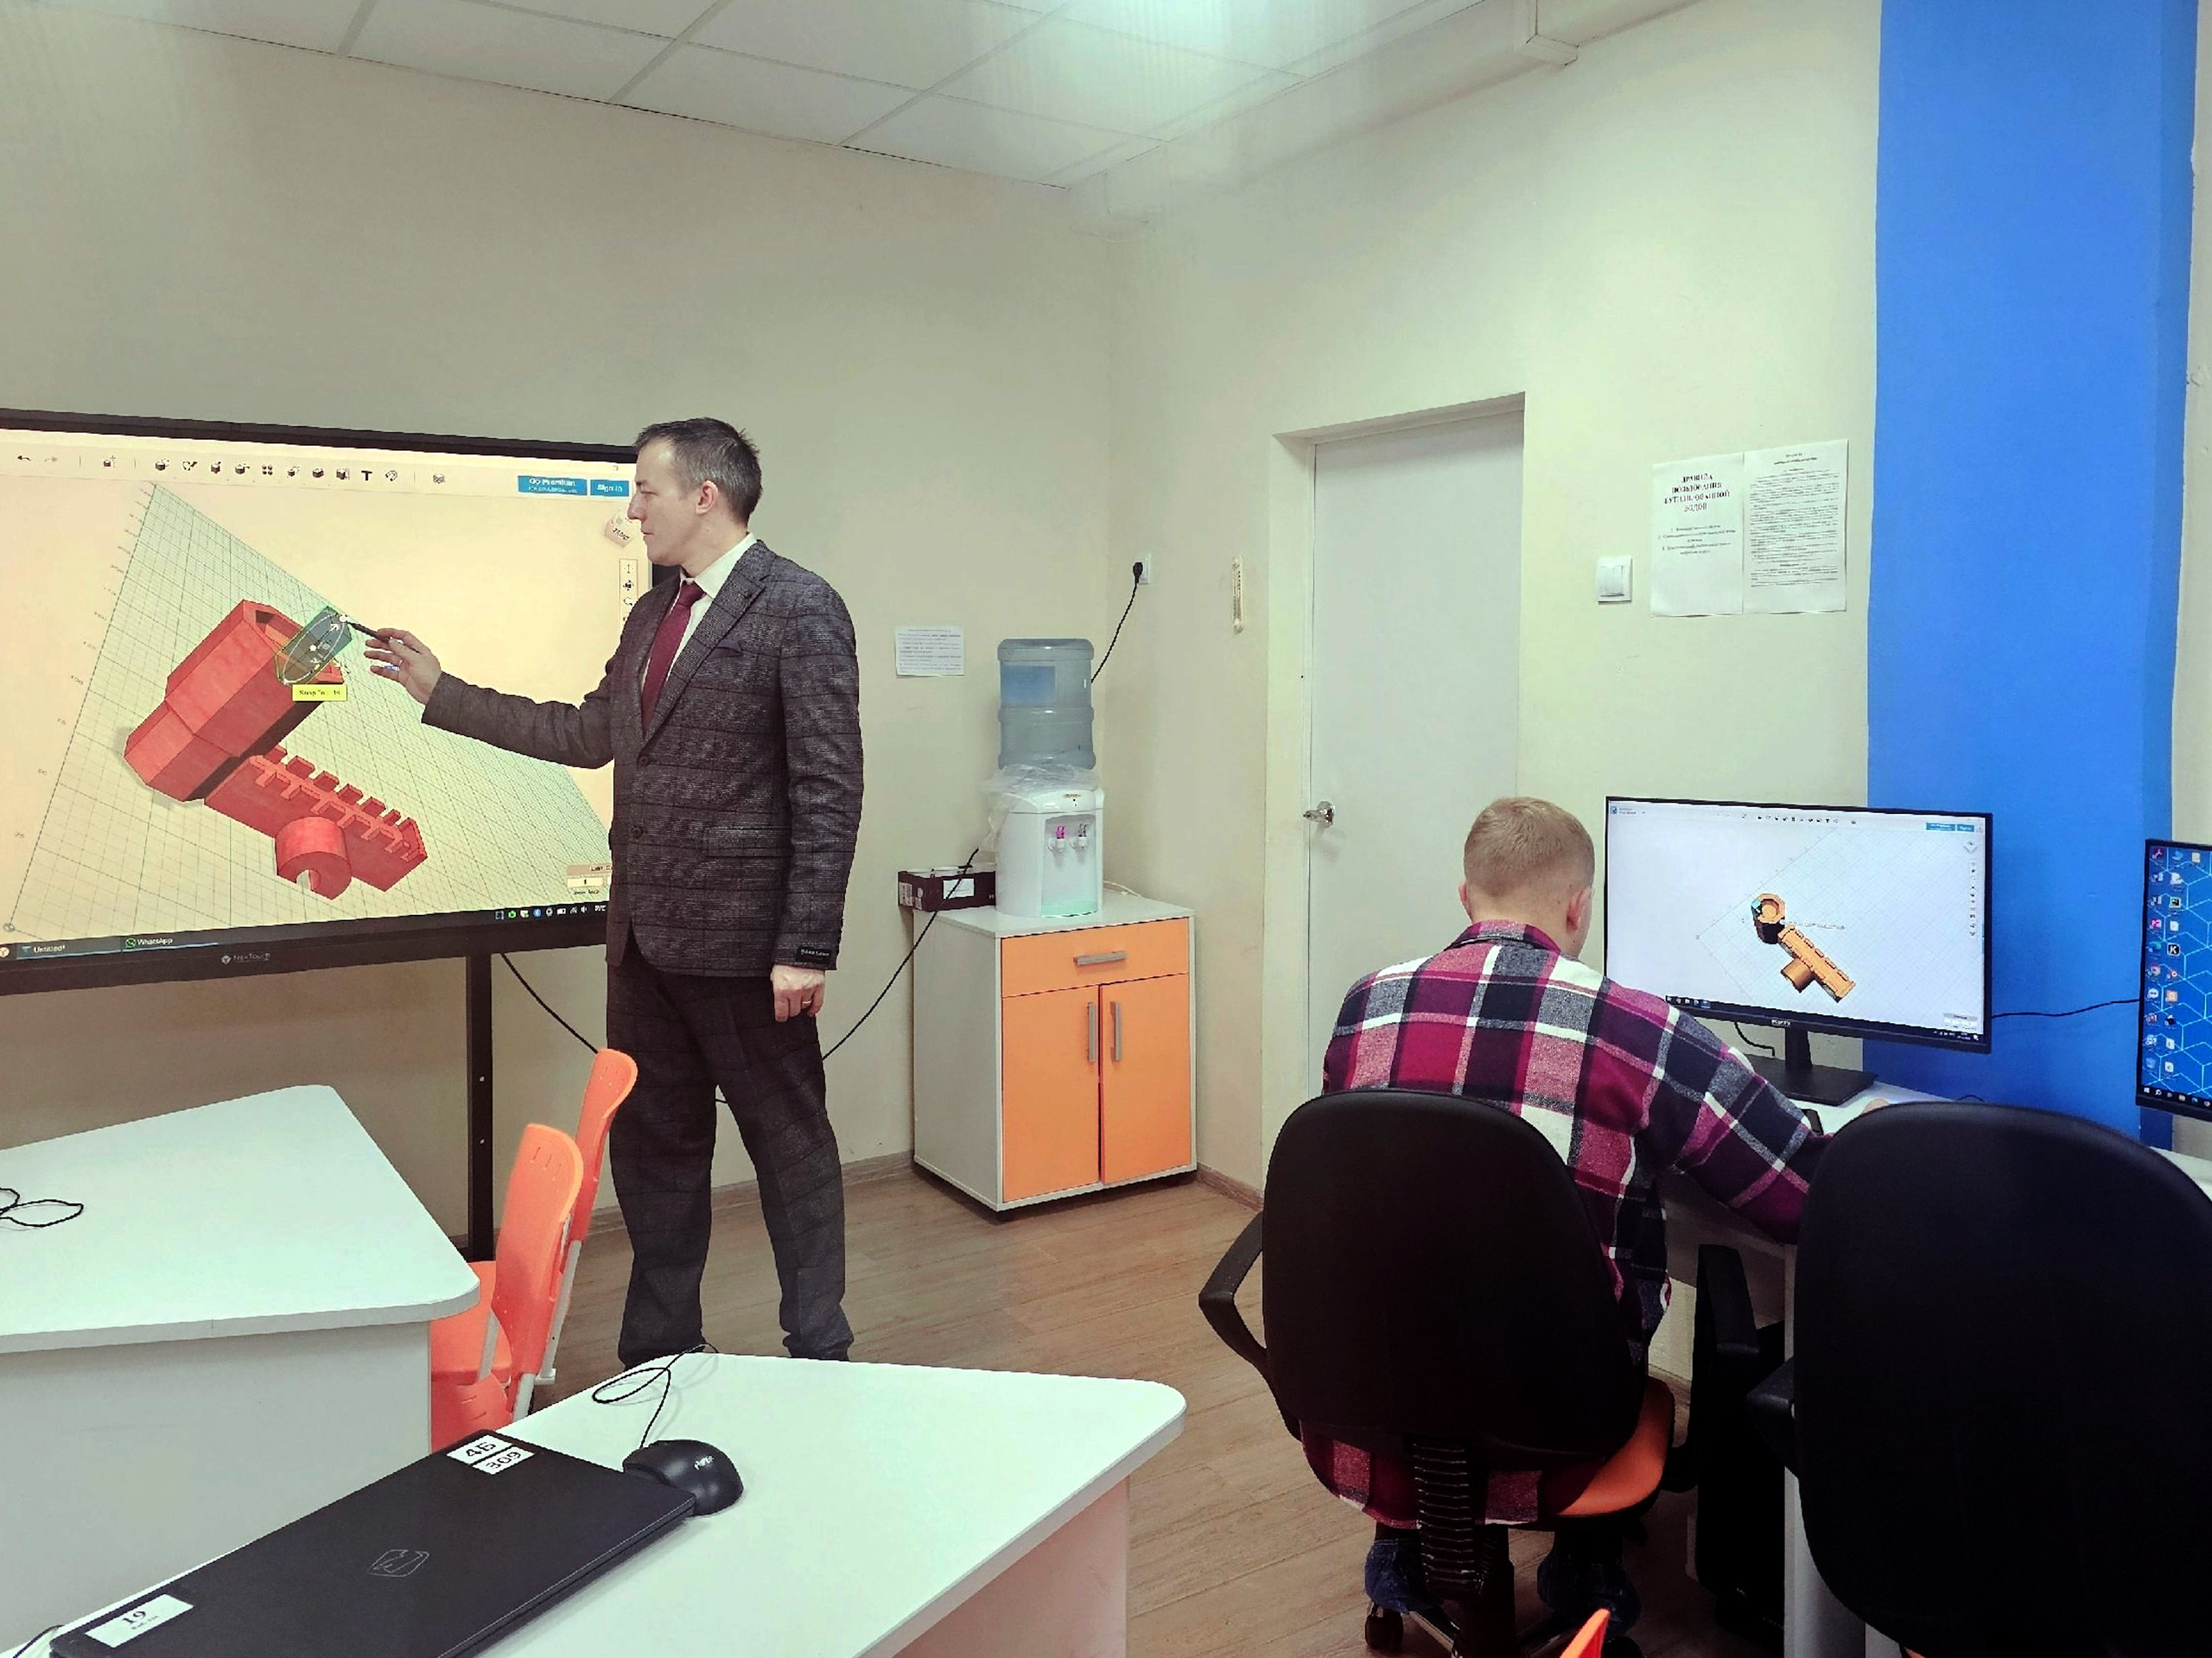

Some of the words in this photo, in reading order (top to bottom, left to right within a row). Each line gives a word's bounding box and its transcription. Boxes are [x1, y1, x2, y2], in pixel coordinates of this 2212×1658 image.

[596, 484, 613, 492] Sign
[137, 937, 173, 947] WhatsApp
[486, 1452, 521, 1470] 309
[122, 1610, 146, 1625] 19
